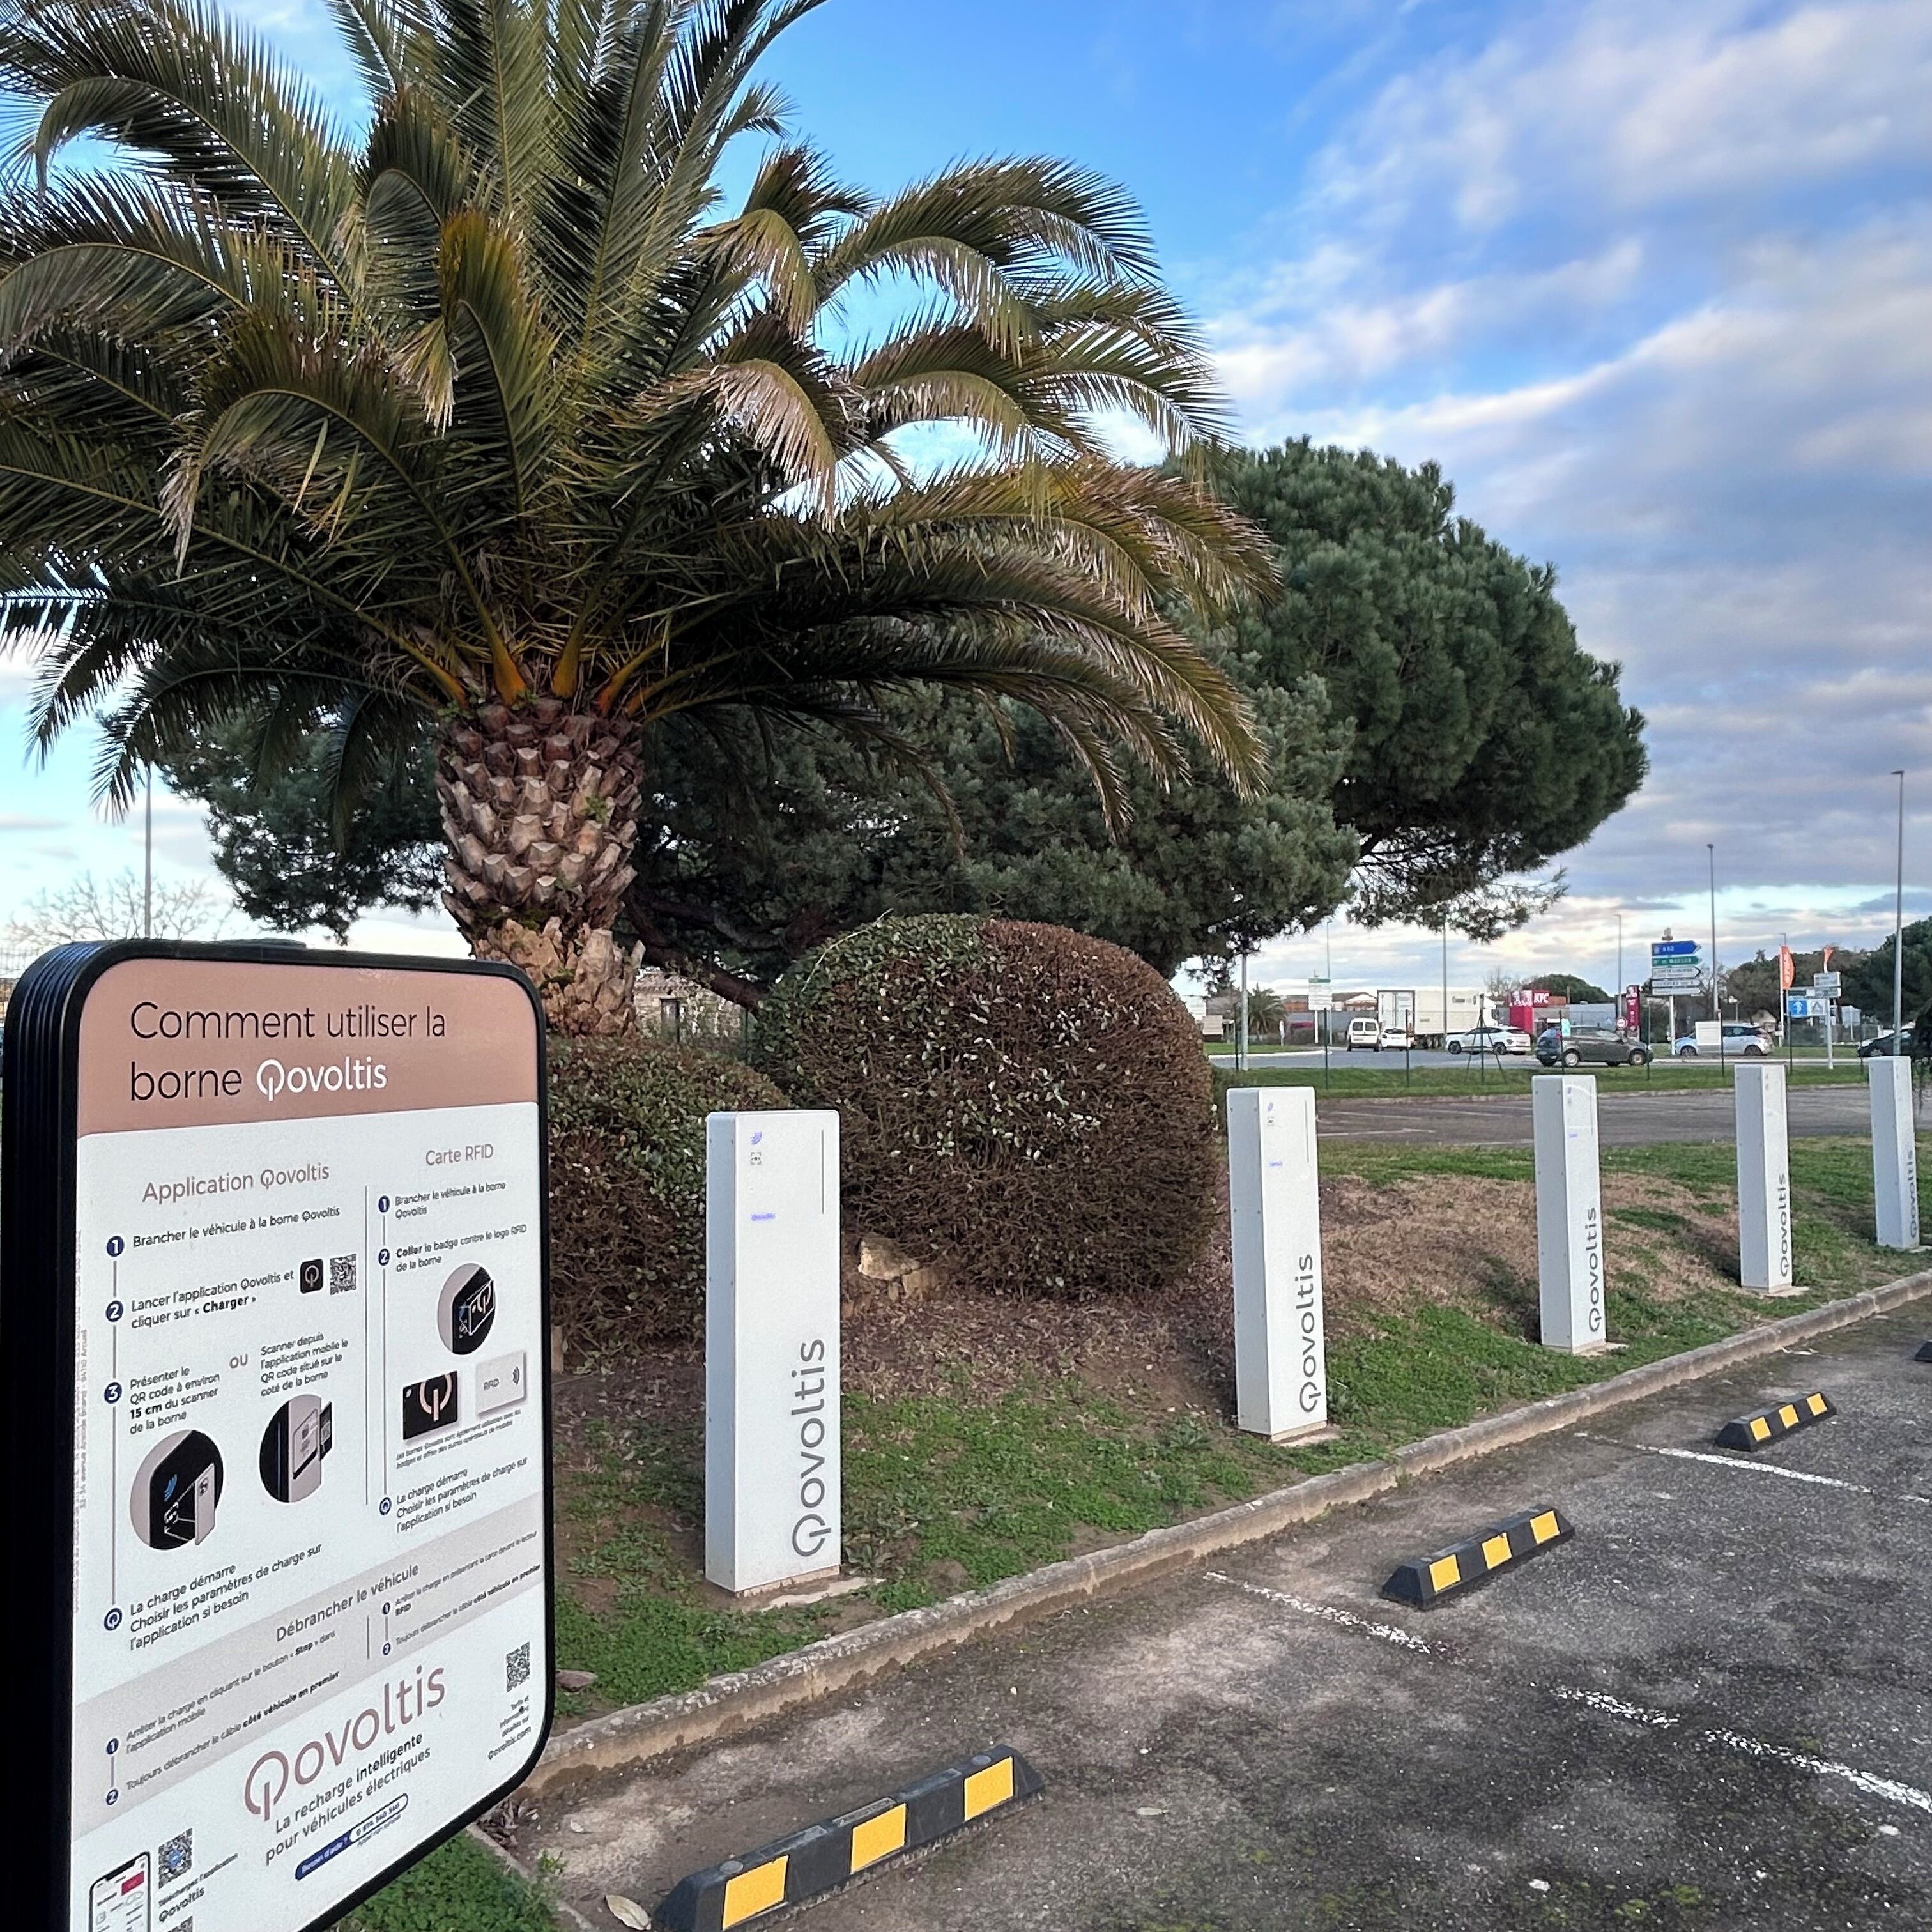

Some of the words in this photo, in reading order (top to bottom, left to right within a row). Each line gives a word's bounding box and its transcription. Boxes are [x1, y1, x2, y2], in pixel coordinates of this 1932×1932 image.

[131, 1002, 316, 1039] Comment
[326, 1005, 418, 1038] utiliser
[426, 1006, 446, 1038] la
[131, 1061, 242, 1101] borne
[256, 1057, 387, 1101] Qovoltis
[425, 1149, 461, 1166] Carte
[465, 1144, 493, 1161] RFID
[142, 1172, 253, 1204] Application
[260, 1162, 329, 1190] Qovoltis
[133, 1230, 185, 1248] Brancher
[189, 1227, 199, 1239] le
[202, 1220, 246, 1237] véhicule
[249, 1218, 255, 1229] à
[258, 1217, 266, 1227] la
[270, 1215, 298, 1226] borne
[302, 1206, 340, 1222] Qovoltis
[1777, 1173, 1791, 1278] Qovoltis
[1584, 1206, 1602, 1333] Qovoltis
[131, 1313, 169, 1328] cliquer
[174, 1308, 190, 1319] sur
[203, 1296, 248, 1313] Charger
[132, 1296, 169, 1312] Lancer
[172, 1282, 237, 1303] l'application
[240, 1272, 280, 1291] Qovoltis
[284, 1270, 294, 1281] et
[261, 1340, 294, 1356] Scanner
[1295, 1252, 1321, 1413] Qovoltis
[130, 1370, 178, 1390] Présenter
[181, 1367, 190, 1376] le
[229, 1353, 249, 1370] OU
[261, 1350, 310, 1370] l'application
[261, 1372, 274, 1383] QR
[276, 1366, 297, 1378] code
[129, 1392, 146, 1405] QR
[148, 1386, 173, 1400] code
[185, 1374, 220, 1390] environ
[130, 1407, 141, 1420] 15
[144, 1404, 162, 1415] cm
[165, 1399, 178, 1410] du
[181, 1388, 218, 1406] scanner
[129, 1423, 142, 1434] de
[146, 1419, 154, 1429] la
[157, 1411, 187, 1427] borne
[791, 1337, 832, 1558] Qovoltis
[396, 1495, 406, 1505] La
[396, 1507, 443, 1533] l'application
[452, 1492, 476, 1508] besoin
[130, 1608, 169, 1632] Choisir
[172, 1600, 188, 1614] les
[192, 1574, 252, 1609] paramètres
[256, 1566, 268, 1579] de
[272, 1552, 304, 1572] charge
[307, 1544, 321, 1557] sur
[130, 1603, 143, 1616] La
[147, 1585, 186, 1609] charge
[189, 1565, 236, 1590] démarre
[276, 1597, 352, 1642] Débrancher
[356, 1590, 367, 1603] le
[371, 1565, 418, 1595] véhicule
[130, 1613, 199, 1651] l'application
[203, 1606, 210, 1618] si
[213, 1591, 249, 1614] besoin
[244, 1665, 446, 1822] Qovoltis
[275, 1816, 290, 1833] La
[295, 1777, 352, 1821] recharge
[356, 1733, 422, 1782] intelligente
[266, 1832, 298, 1866] pour
[303, 1791, 362, 1837] véhicules
[365, 1747, 430, 1796] électriques
